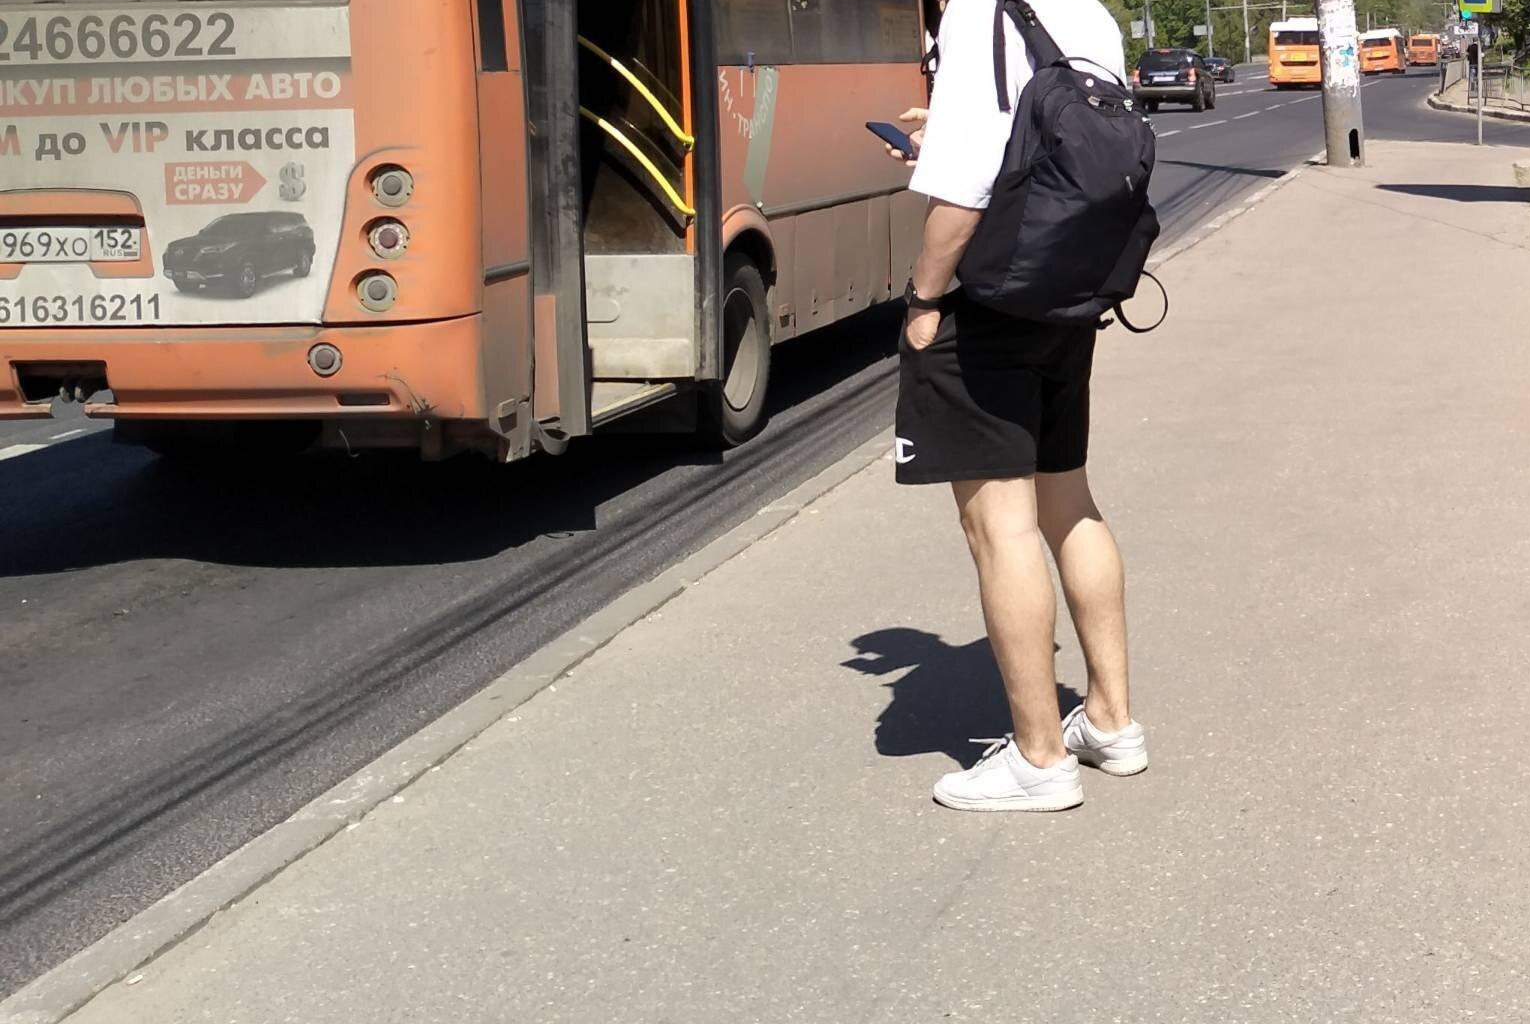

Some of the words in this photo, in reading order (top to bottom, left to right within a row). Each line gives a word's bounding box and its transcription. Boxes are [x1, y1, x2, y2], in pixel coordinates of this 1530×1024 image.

[0, 78, 75, 105] КУП
[88, 74, 234, 104] ЛЮБЫХ
[245, 71, 341, 100] АВТО
[35, 132, 87, 161] до
[99, 121, 169, 153] VIP
[185, 126, 330, 152] класса
[174, 165, 243, 182] ДЕНЬГИ
[174, 183, 244, 201] СРАЗУ
[94, 229, 132, 250] 152
